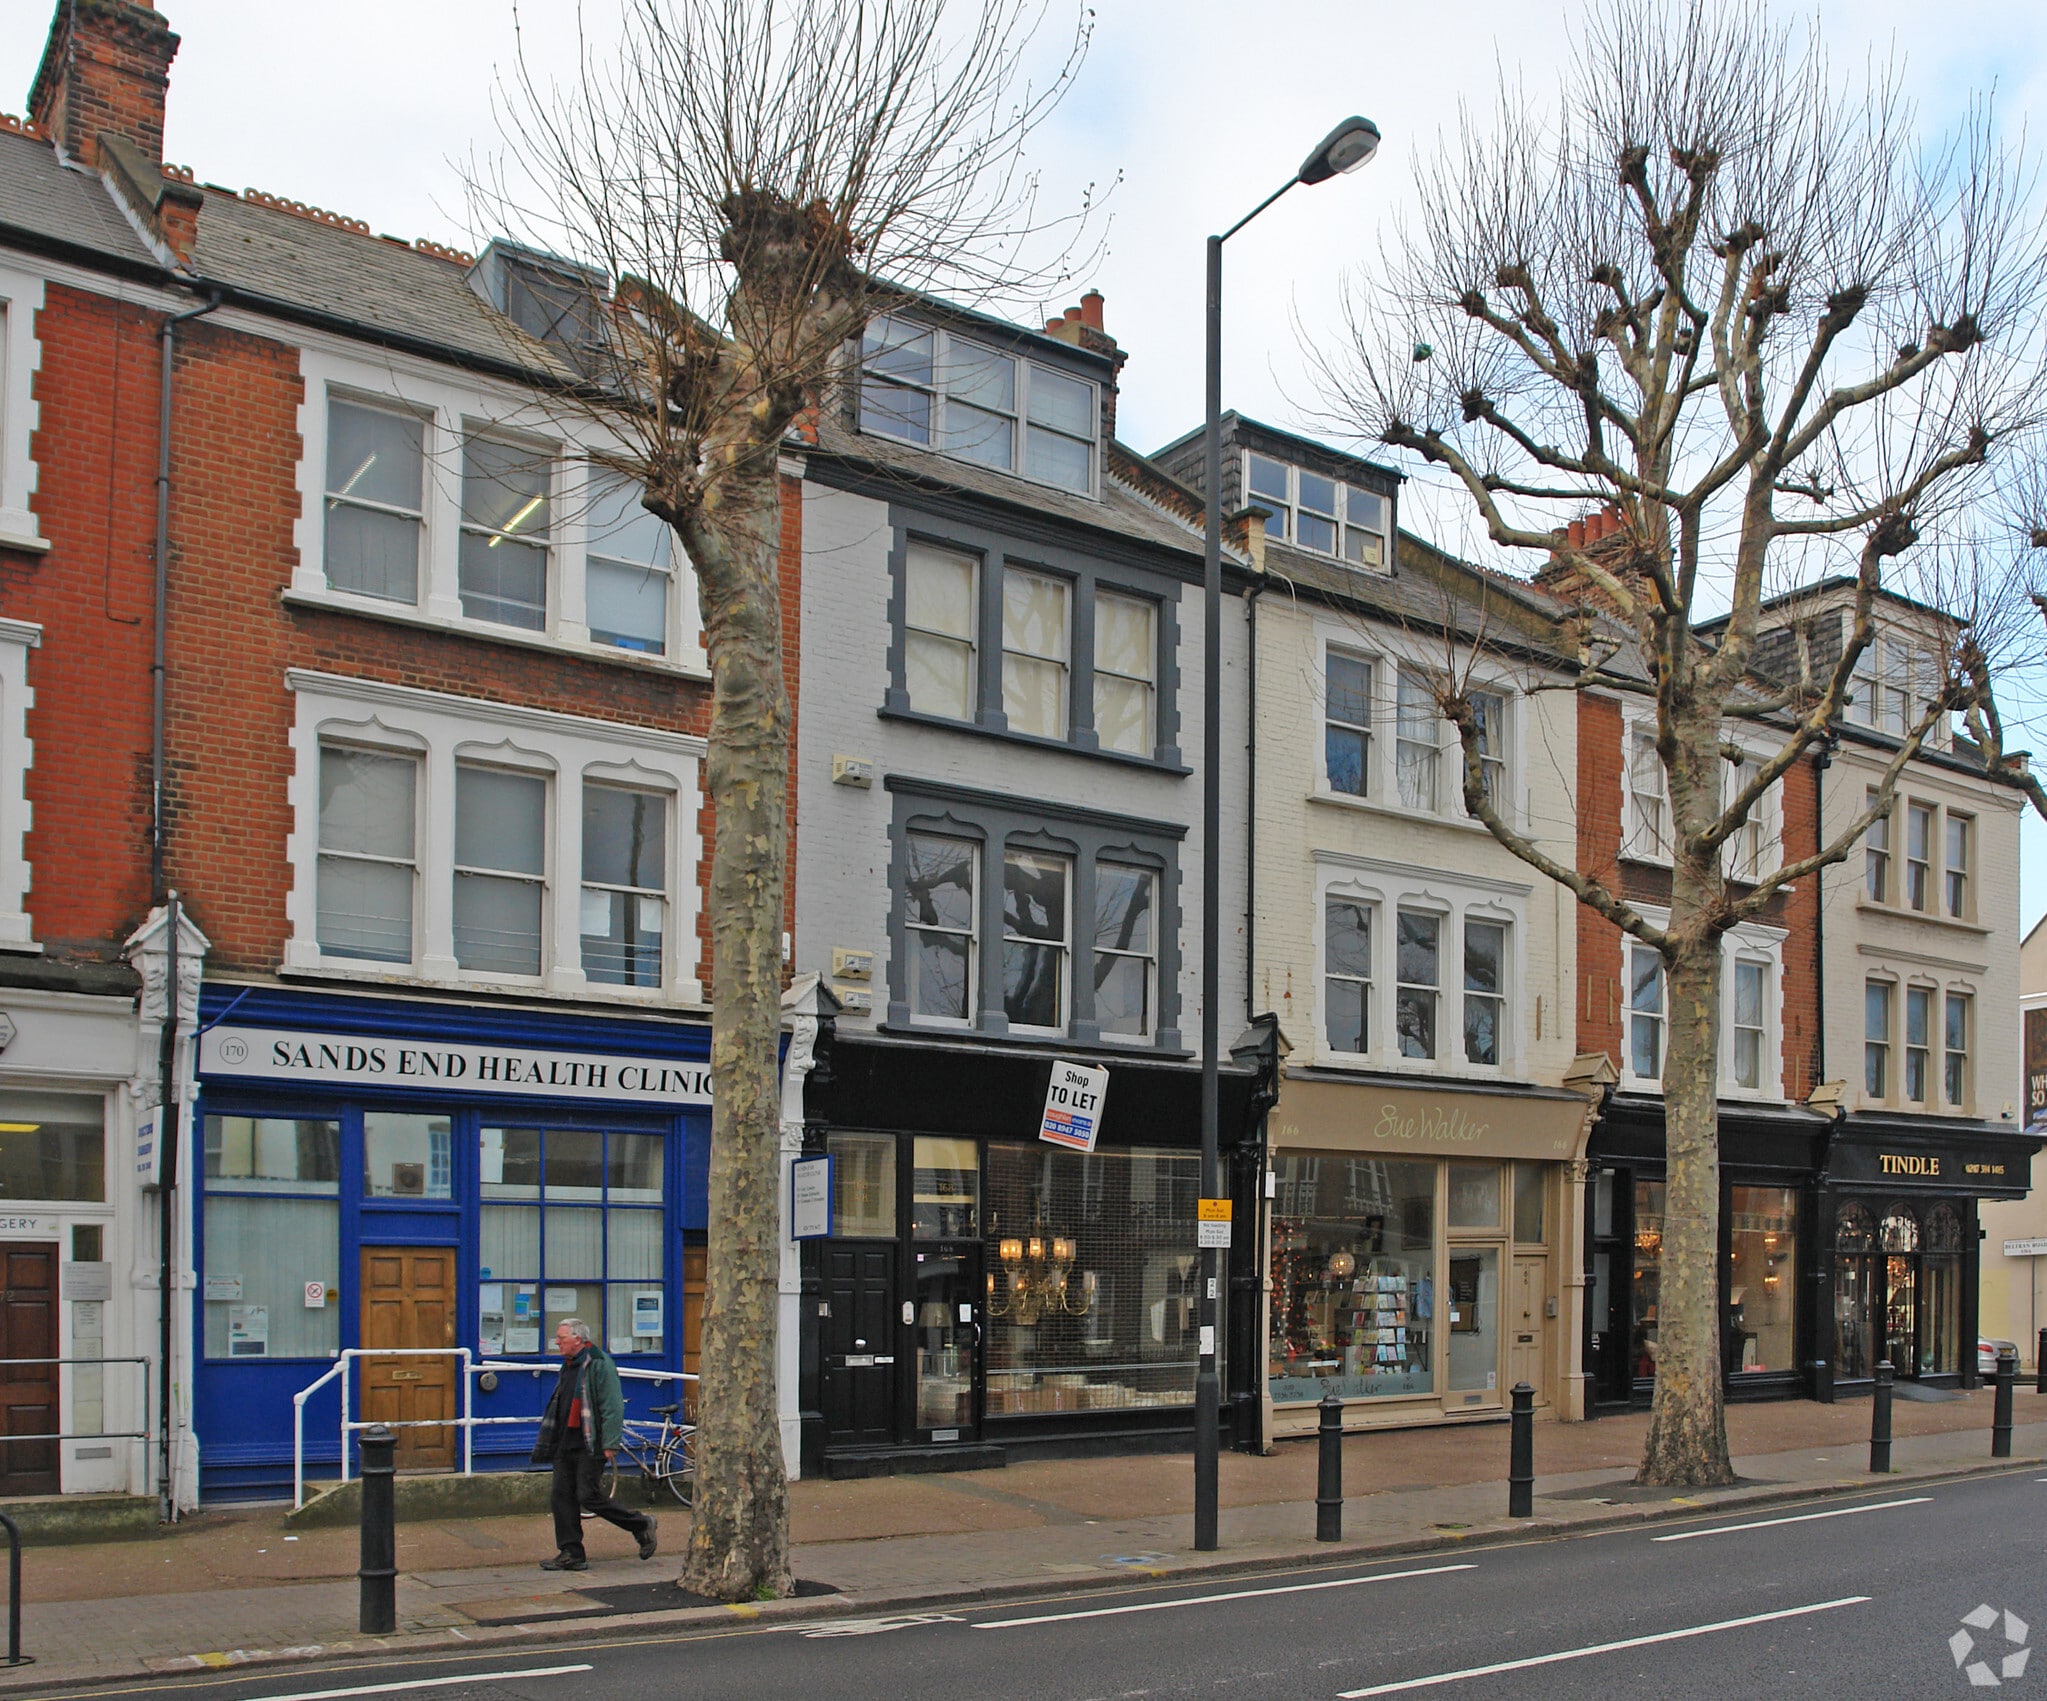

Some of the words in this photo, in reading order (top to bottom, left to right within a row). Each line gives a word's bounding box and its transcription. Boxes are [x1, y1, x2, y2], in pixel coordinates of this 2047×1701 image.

[224, 1044, 244, 1057] 170
[272, 1040, 386, 1073] SANDS
[397, 1049, 466, 1078] END
[478, 1055, 609, 1088] HEALTH
[1065, 1070, 1089, 1088] Shop
[1051, 1085, 1068, 1104] TO
[1072, 1091, 1097, 1111] LET
[2031, 1090, 2046, 1106] SO
[1374, 1104, 1415, 1138] Sue
[1420, 1107, 1490, 1142] Walker
[1880, 1154, 1940, 1176] TINDLE
